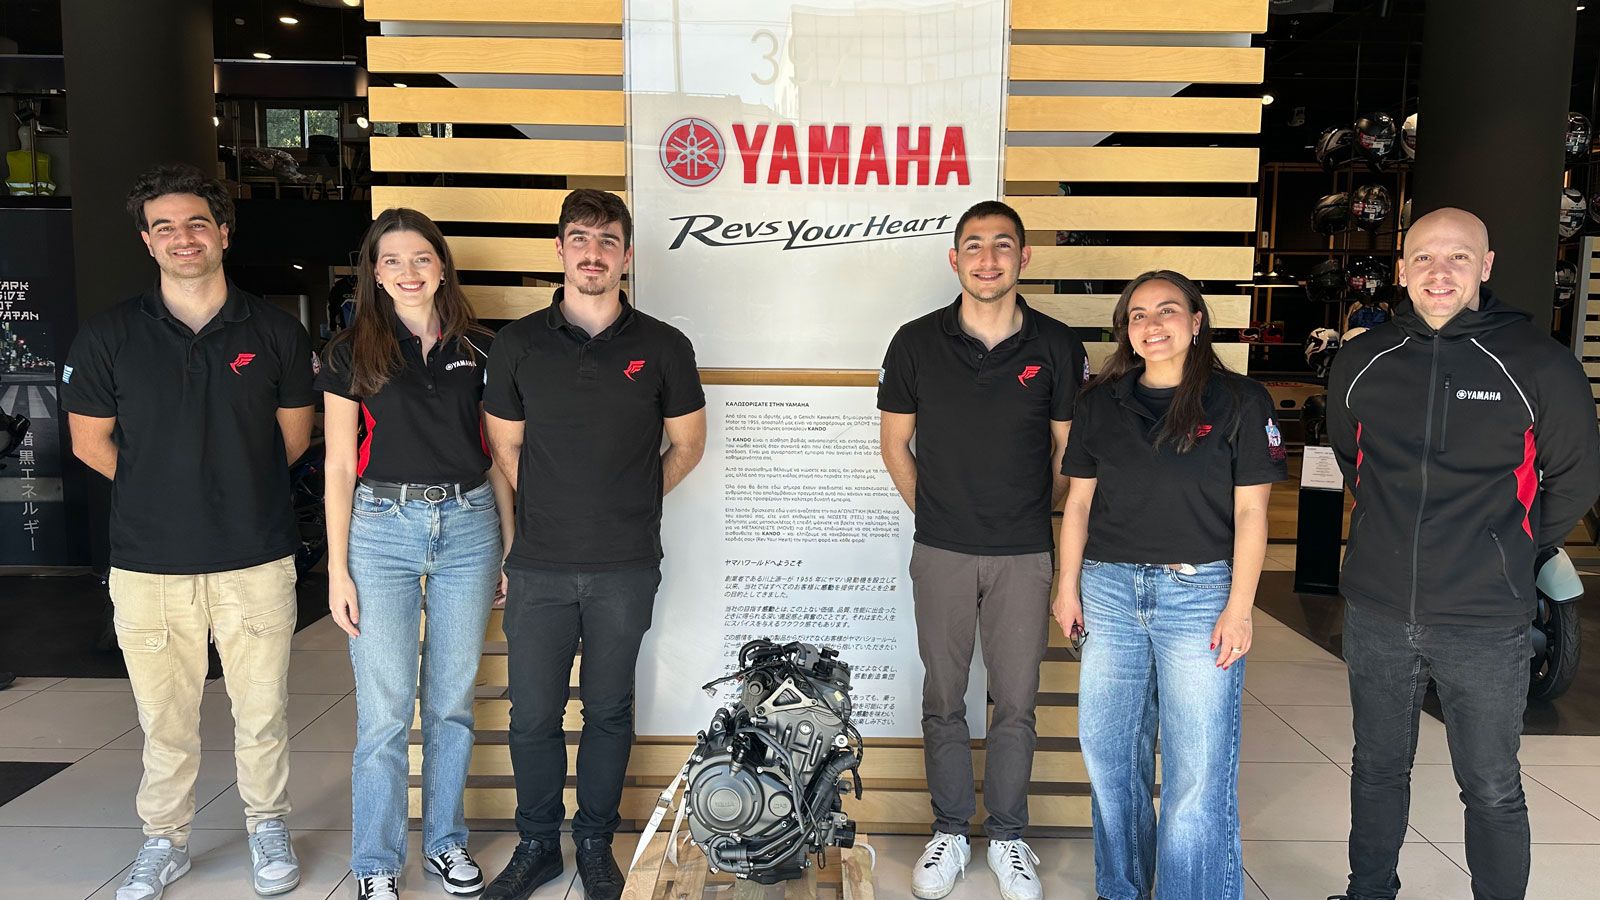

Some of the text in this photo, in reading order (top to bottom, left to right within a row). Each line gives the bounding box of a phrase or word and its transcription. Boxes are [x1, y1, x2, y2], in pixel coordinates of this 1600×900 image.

[732, 123, 971, 186] YAMAHA
[669, 214, 952, 250] Revs Your Heart
[0, 281, 29, 291] ARK
[1467, 390, 1501, 401] YAMAHA
[18, 431, 40, 552] 暗黒エネルギー
[725, 559, 803, 567] ヤマハワールドへようこそ
